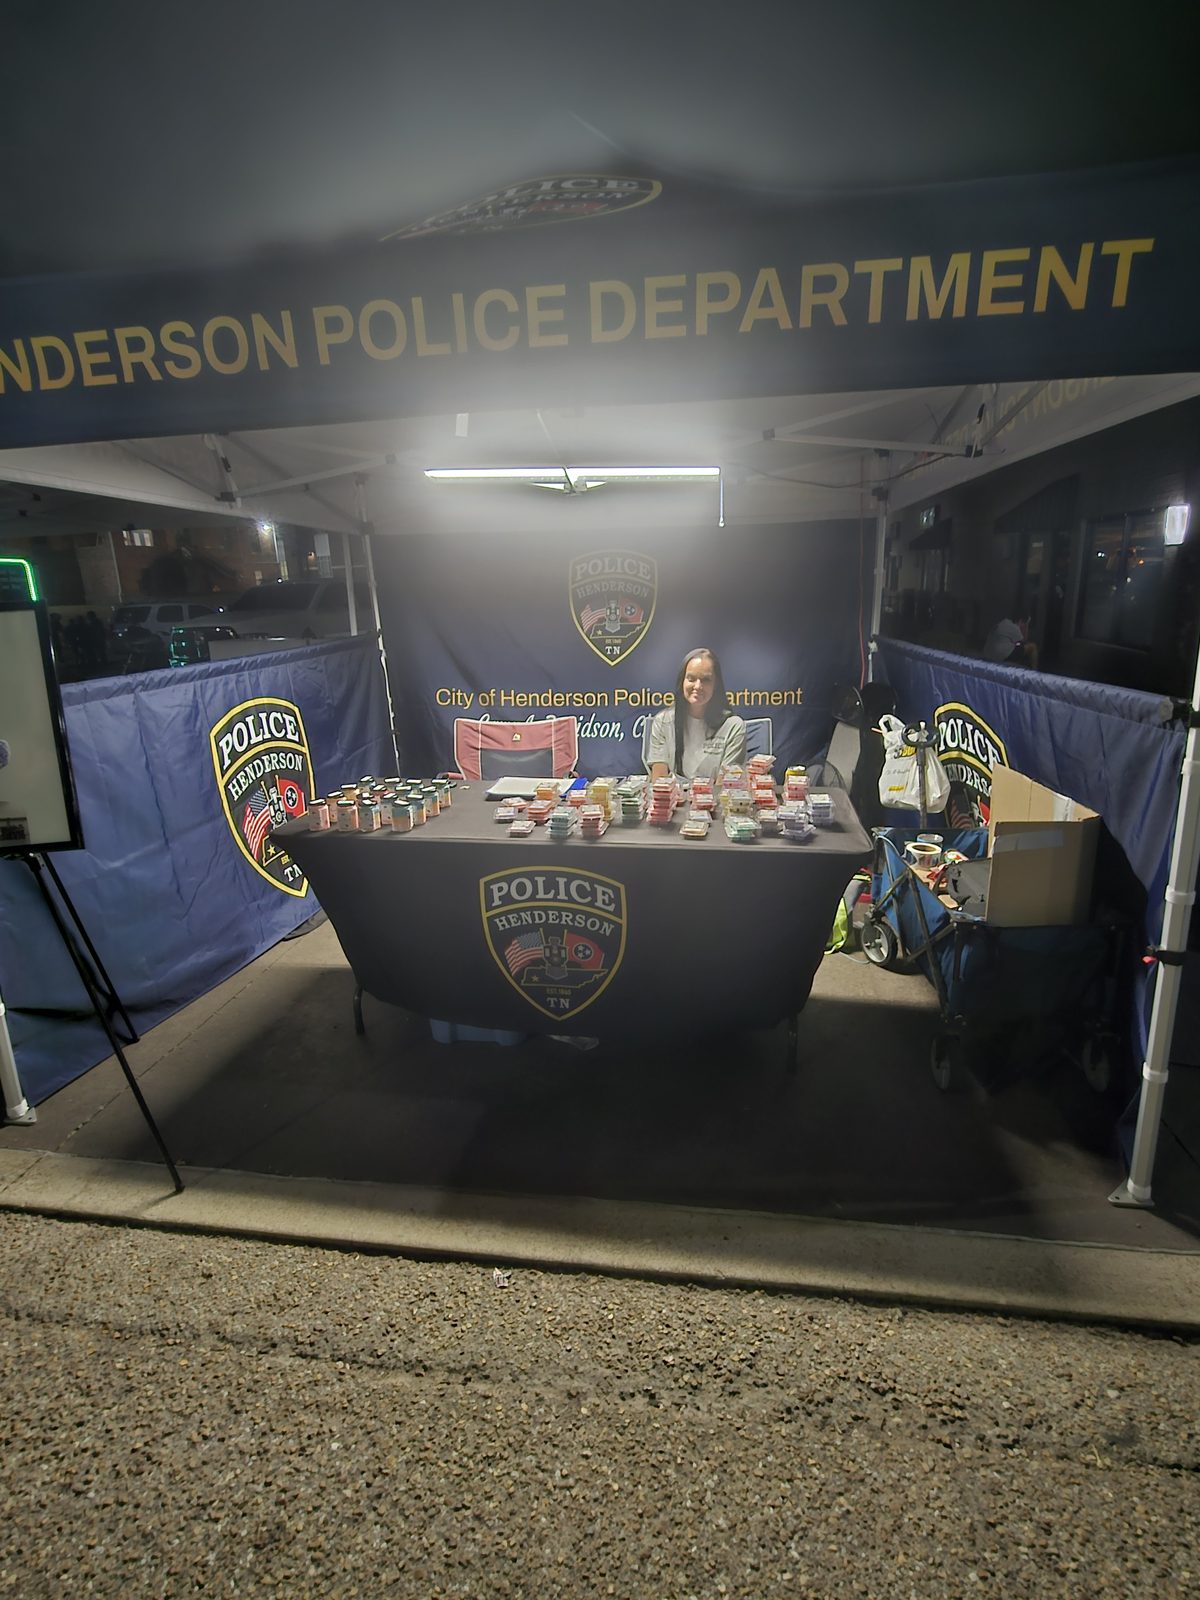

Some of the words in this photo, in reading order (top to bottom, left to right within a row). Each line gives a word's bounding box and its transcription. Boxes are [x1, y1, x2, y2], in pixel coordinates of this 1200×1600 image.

[312, 284, 569, 366] POLICE
[589, 238, 1155, 343] DEPARTMENT
[575, 557, 651, 580] POLICE
[576, 581, 650, 599] HENDERSON
[605, 646, 621, 655] TN
[436, 688, 474, 709] City
[478, 689, 496, 706] of
[501, 689, 608, 707] Henderson
[614, 688, 675, 706] Police
[725, 688, 802, 705] artment
[219, 711, 299, 770] POLICE
[228, 753, 304, 801] HENDERSON
[490, 876, 616, 912] POLICE
[494, 910, 615, 937] HENDERSON
[547, 998, 570, 1008] TN
